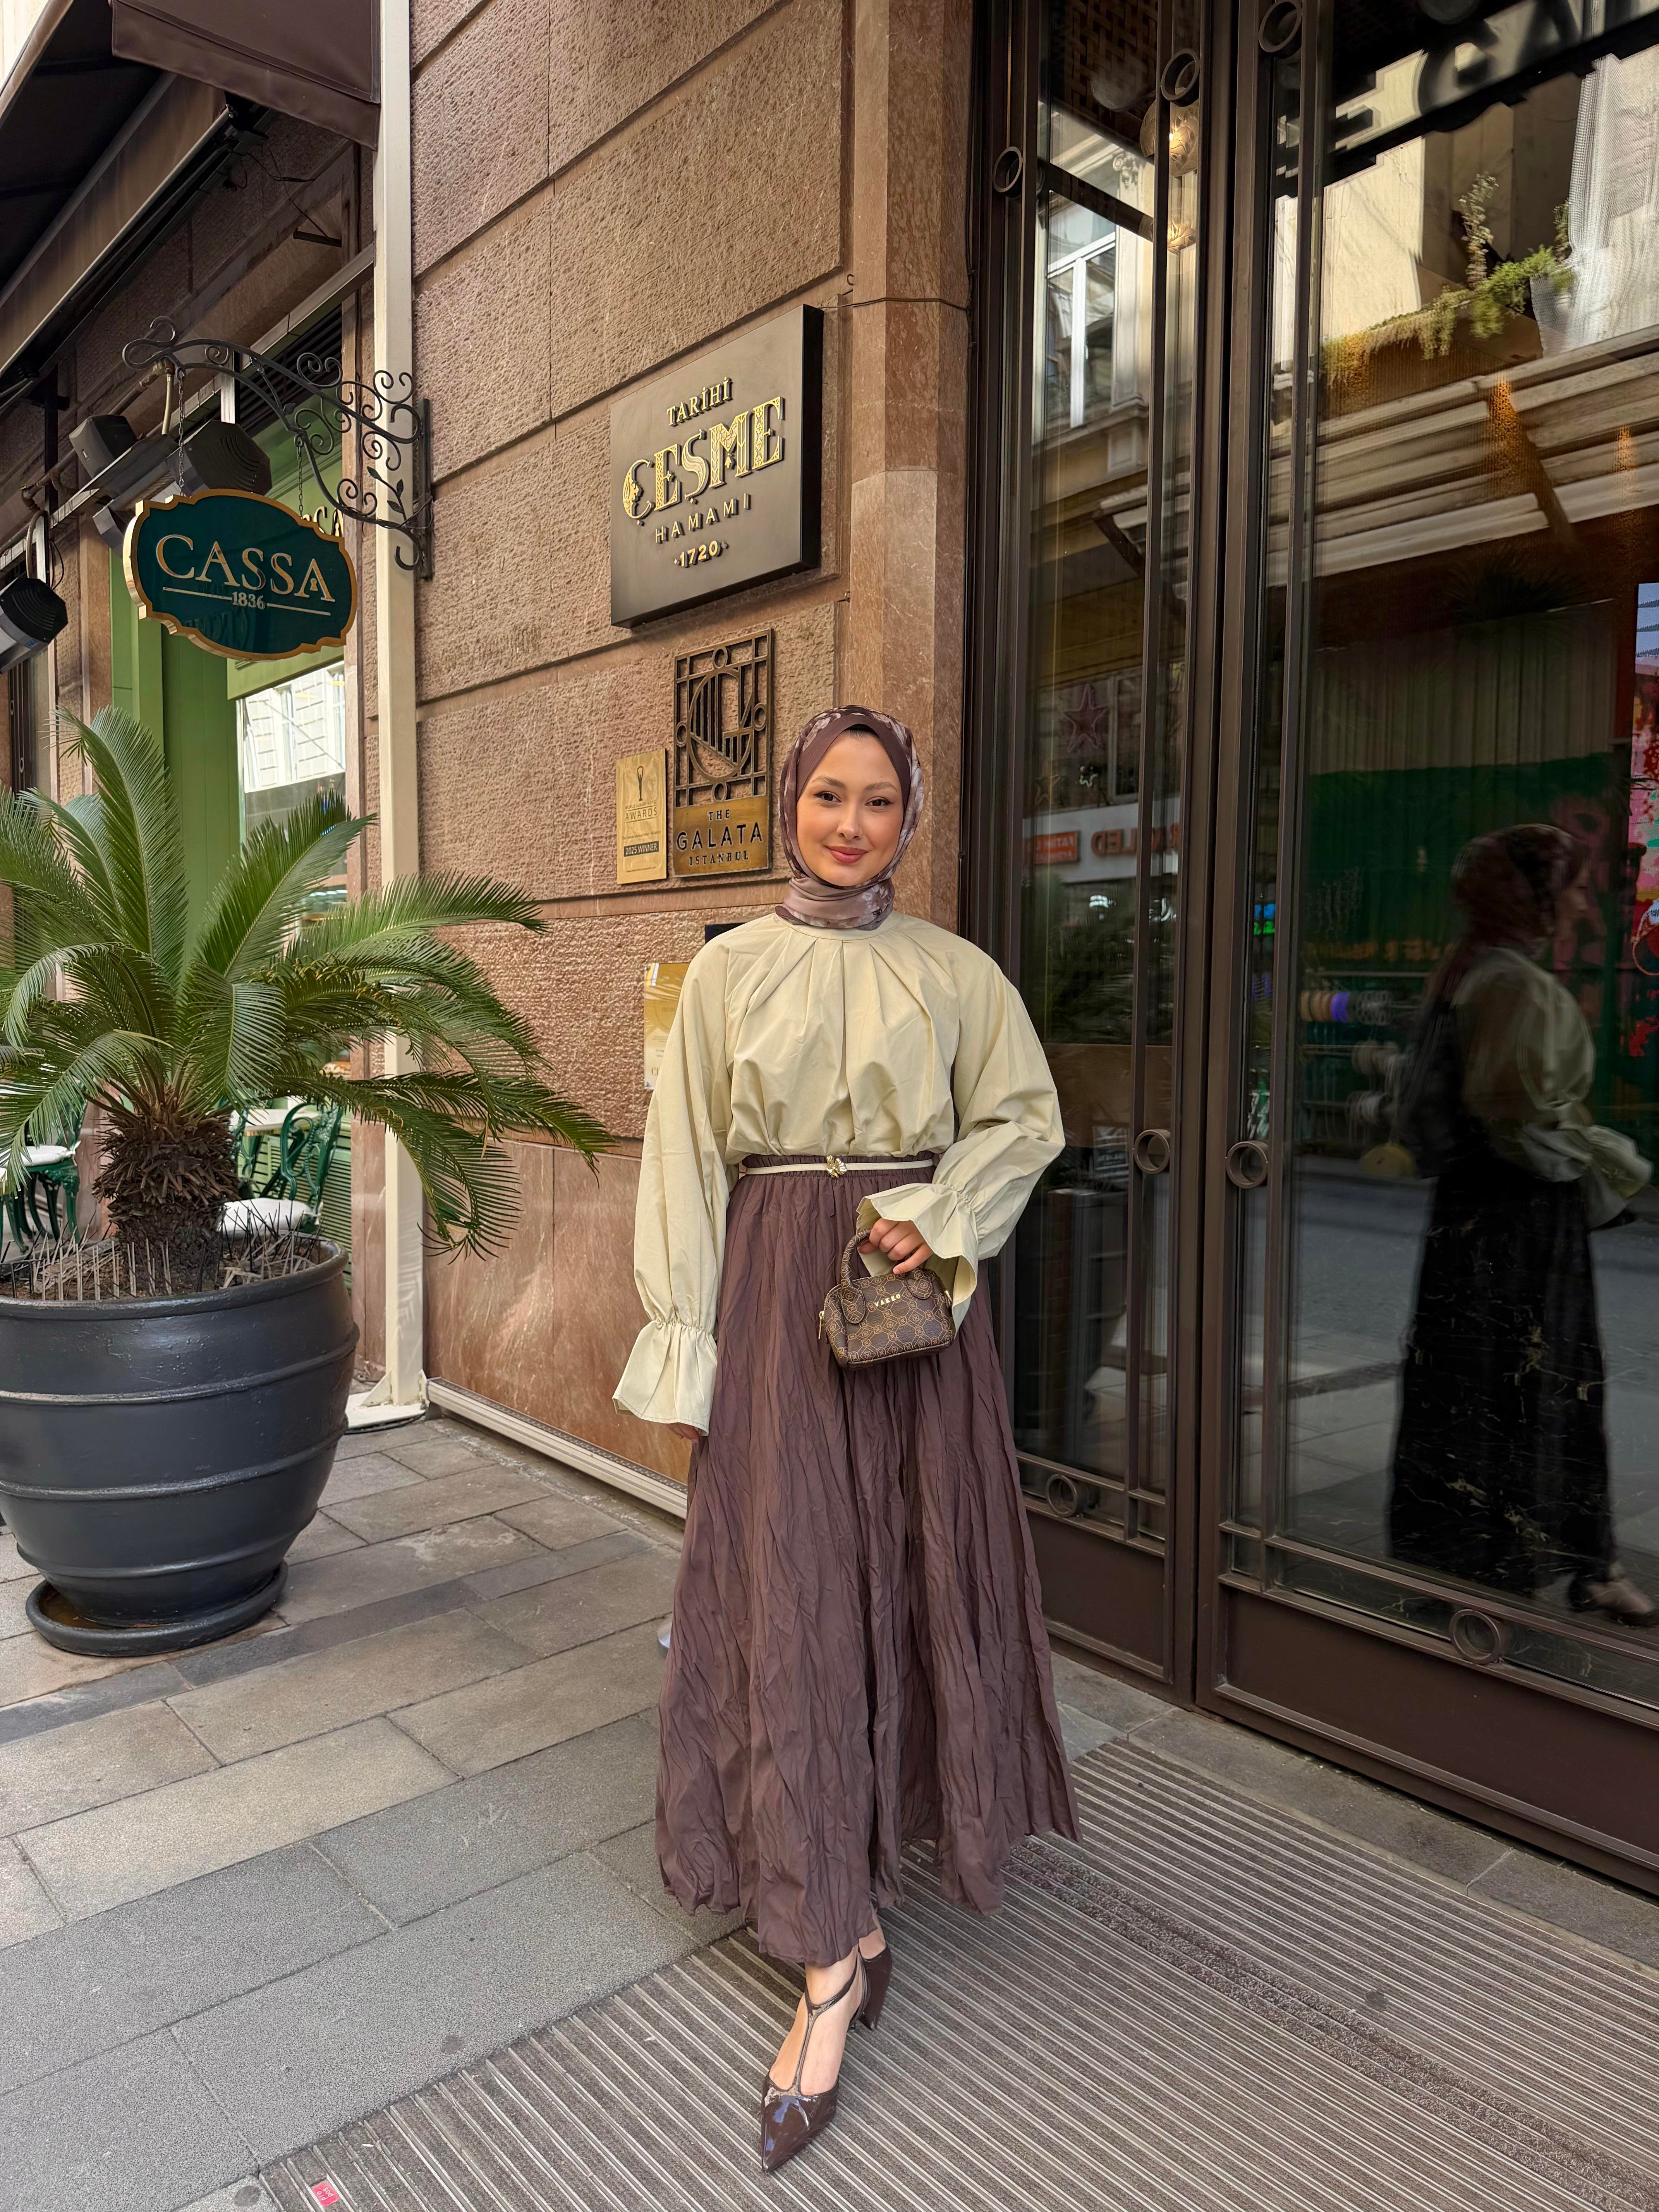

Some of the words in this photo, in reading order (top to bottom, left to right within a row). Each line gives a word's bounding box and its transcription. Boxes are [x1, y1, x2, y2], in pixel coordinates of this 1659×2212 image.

[666, 376, 732, 426] TARİHİ
[622, 397, 784, 526] ÇEŞME
[655, 493, 750, 543] HAMAMI
[156, 534, 335, 602] CASSA
[232, 591, 266, 610] 1836
[625, 807, 657, 821] AWARDS
[708, 809, 730, 821] THE
[677, 822, 763, 851] GALATA
[625, 846, 637, 855] 2025
[638, 843, 658, 853] WINNER
[689, 850, 749, 866] ISTANBUL
[874, 1294, 901, 1307] VAKKO
